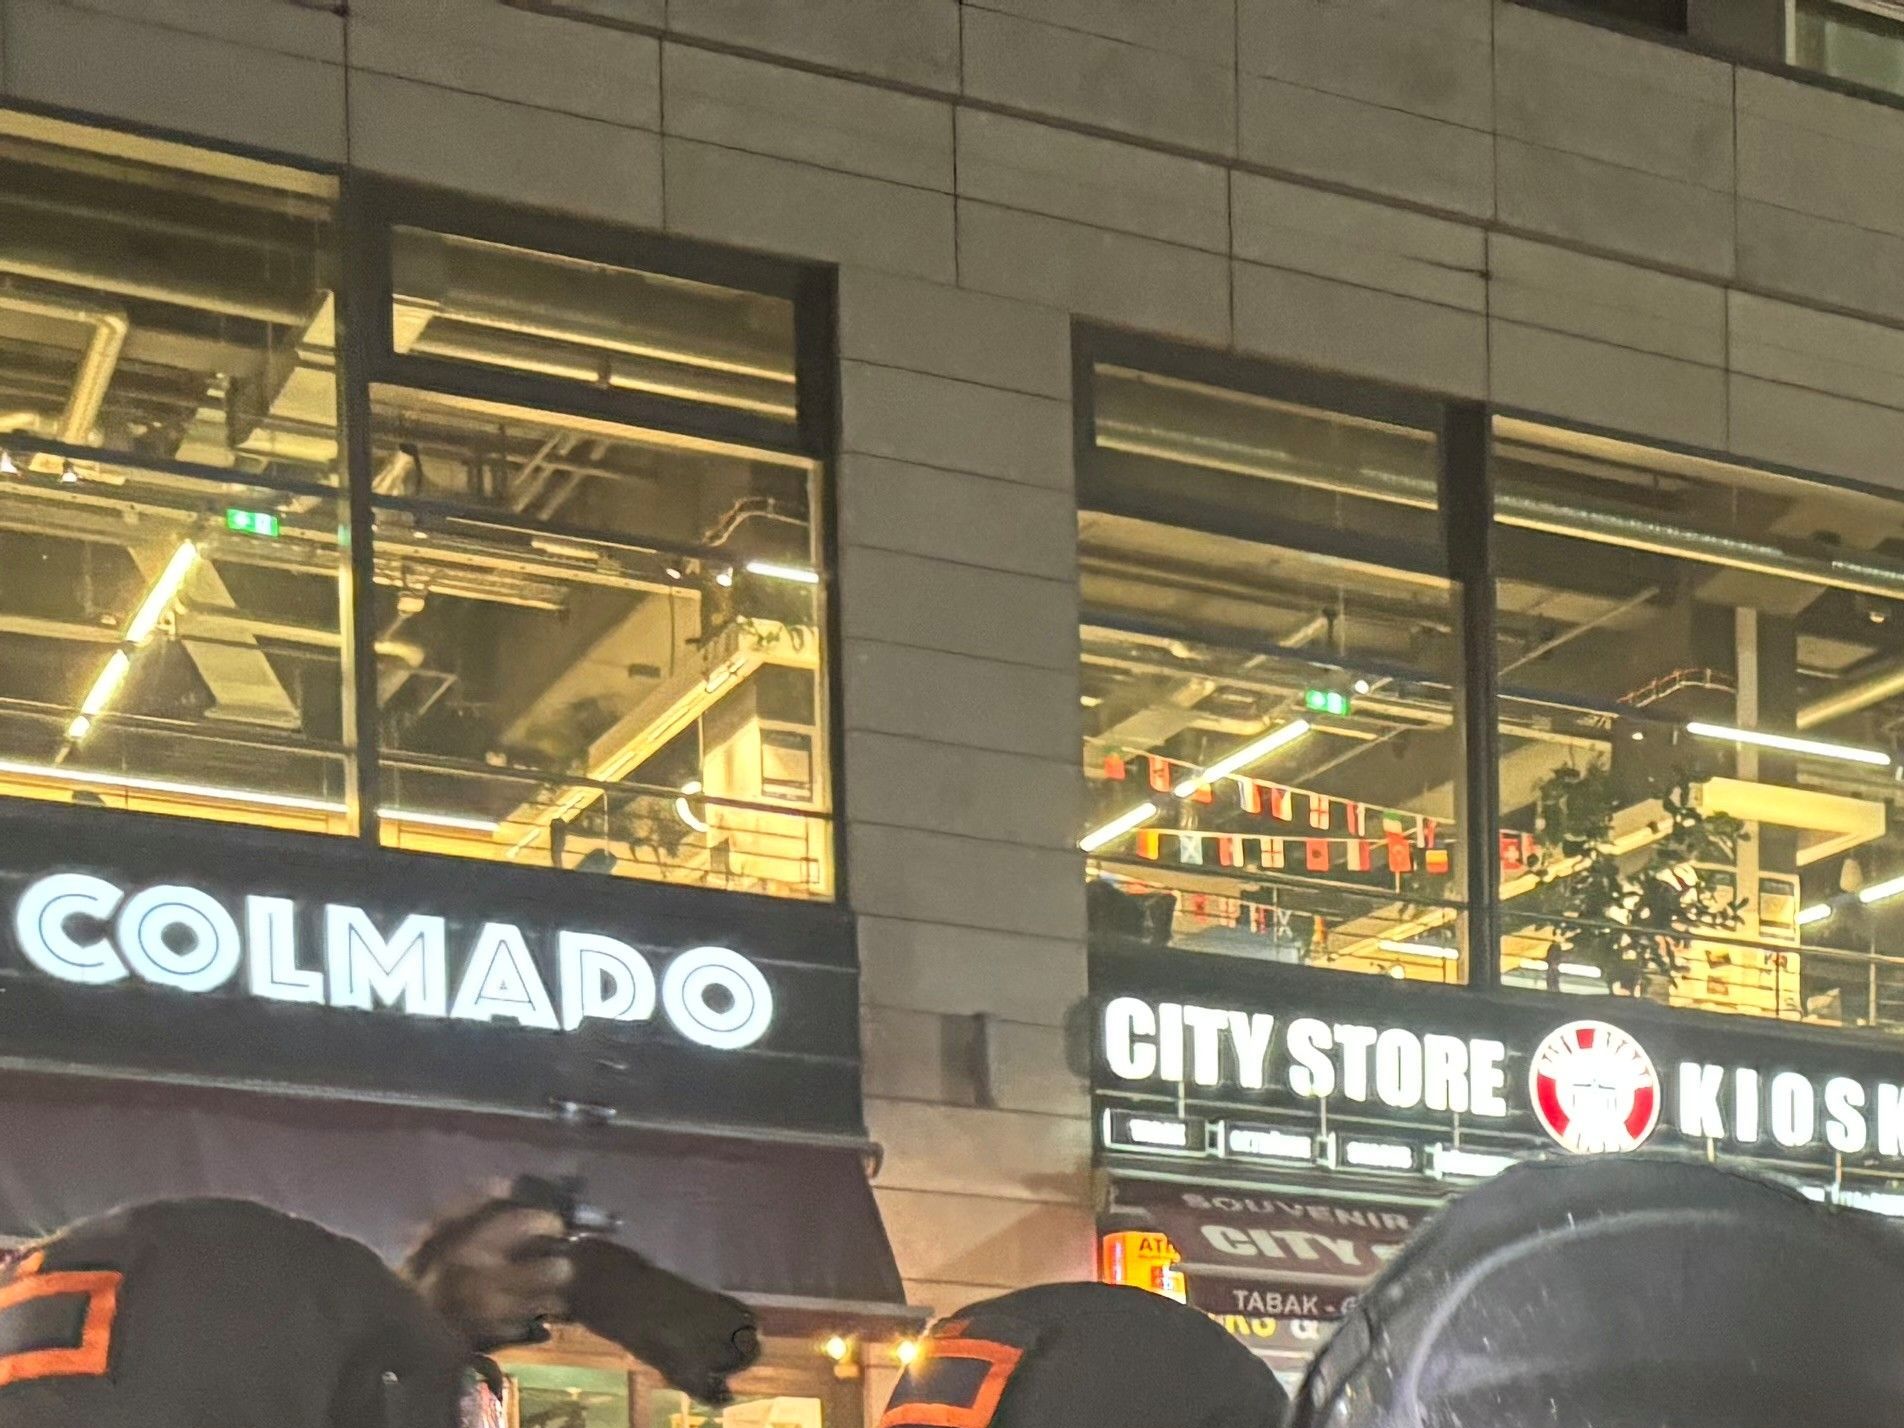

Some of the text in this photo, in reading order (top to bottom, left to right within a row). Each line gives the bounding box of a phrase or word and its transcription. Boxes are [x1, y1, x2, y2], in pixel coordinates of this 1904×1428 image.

[16, 873, 774, 1050] COLMADO
[1104, 996, 1276, 1090] CITY
[1287, 1018, 1508, 1118] STORE
[1200, 1224, 1363, 1266] CITY
[1232, 1289, 1319, 1317] TABAK
